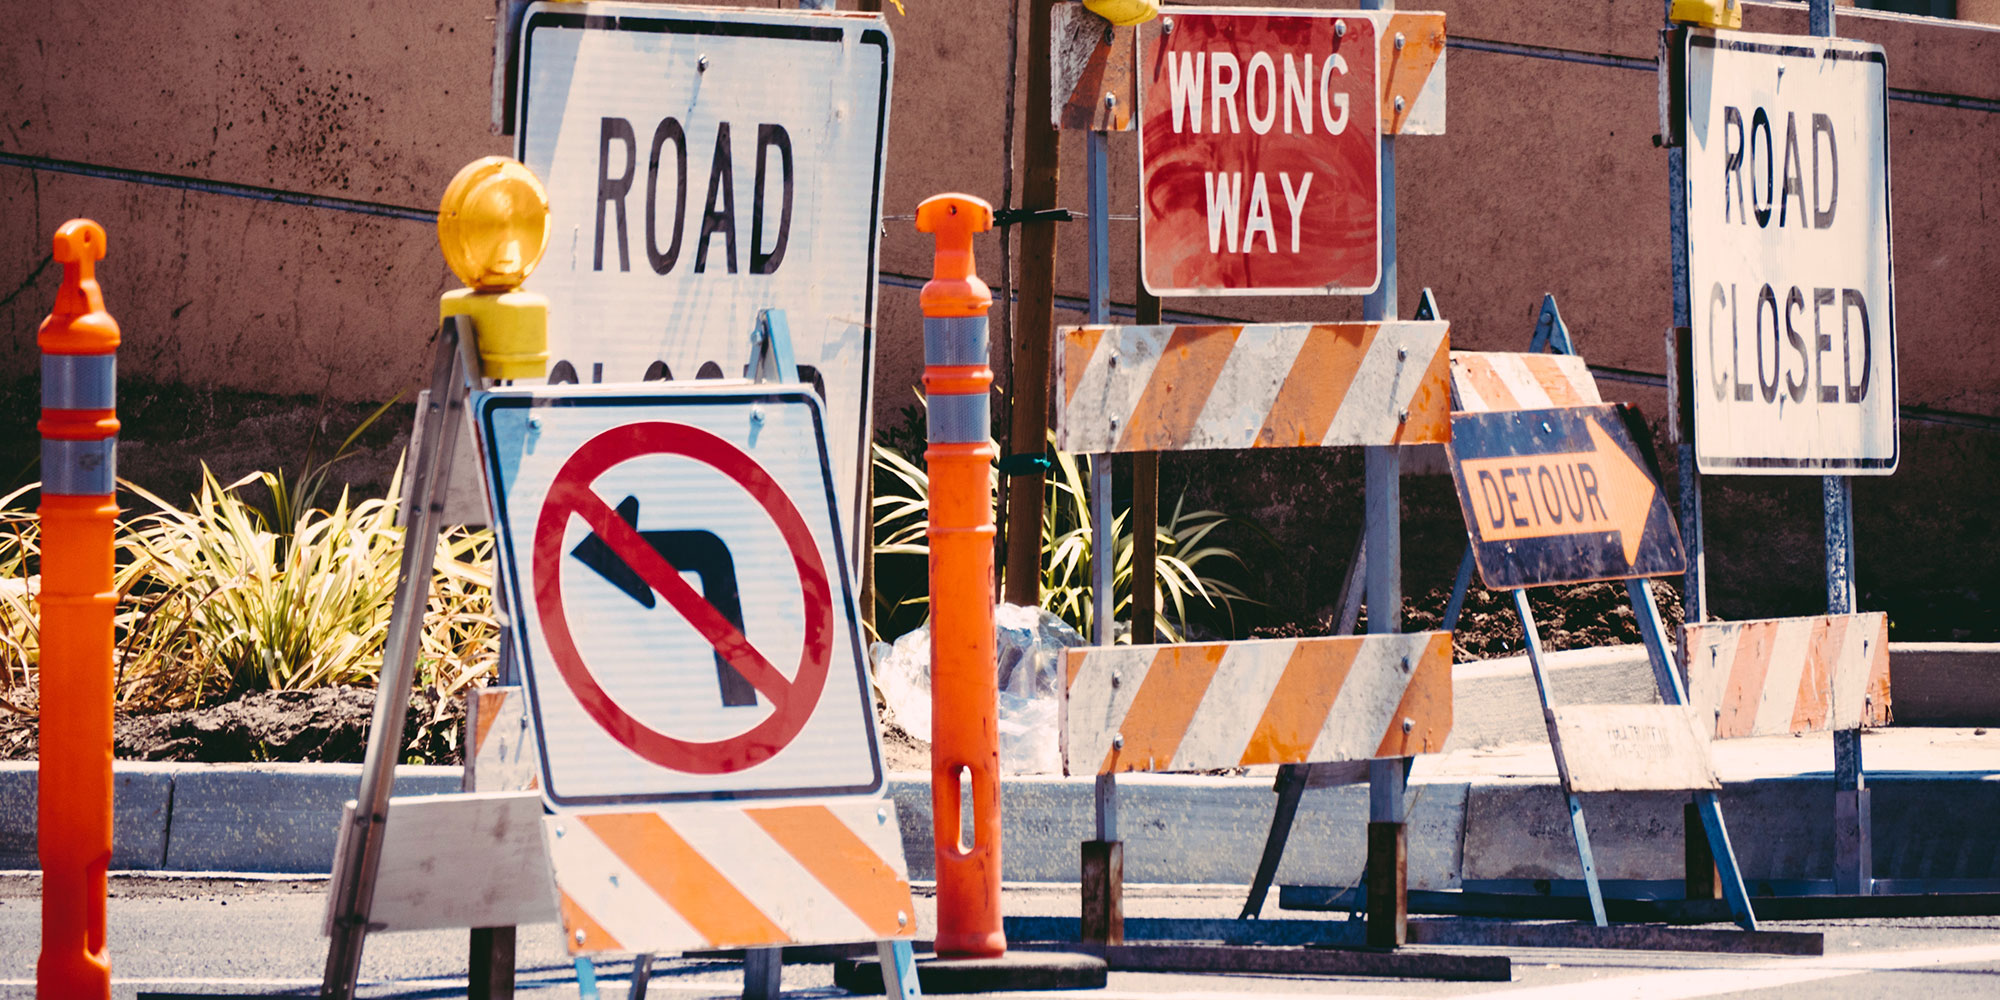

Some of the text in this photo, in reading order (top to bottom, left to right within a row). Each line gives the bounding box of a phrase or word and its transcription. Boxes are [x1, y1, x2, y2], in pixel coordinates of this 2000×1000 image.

[1168, 51, 1350, 135] WRONG
[593, 116, 793, 276] ROAD
[1205, 171, 1314, 254] WAY
[1724, 106, 1839, 230] ROAD
[1708, 281, 1872, 404] CLOSED
[1478, 463, 1608, 529] DETOUR
